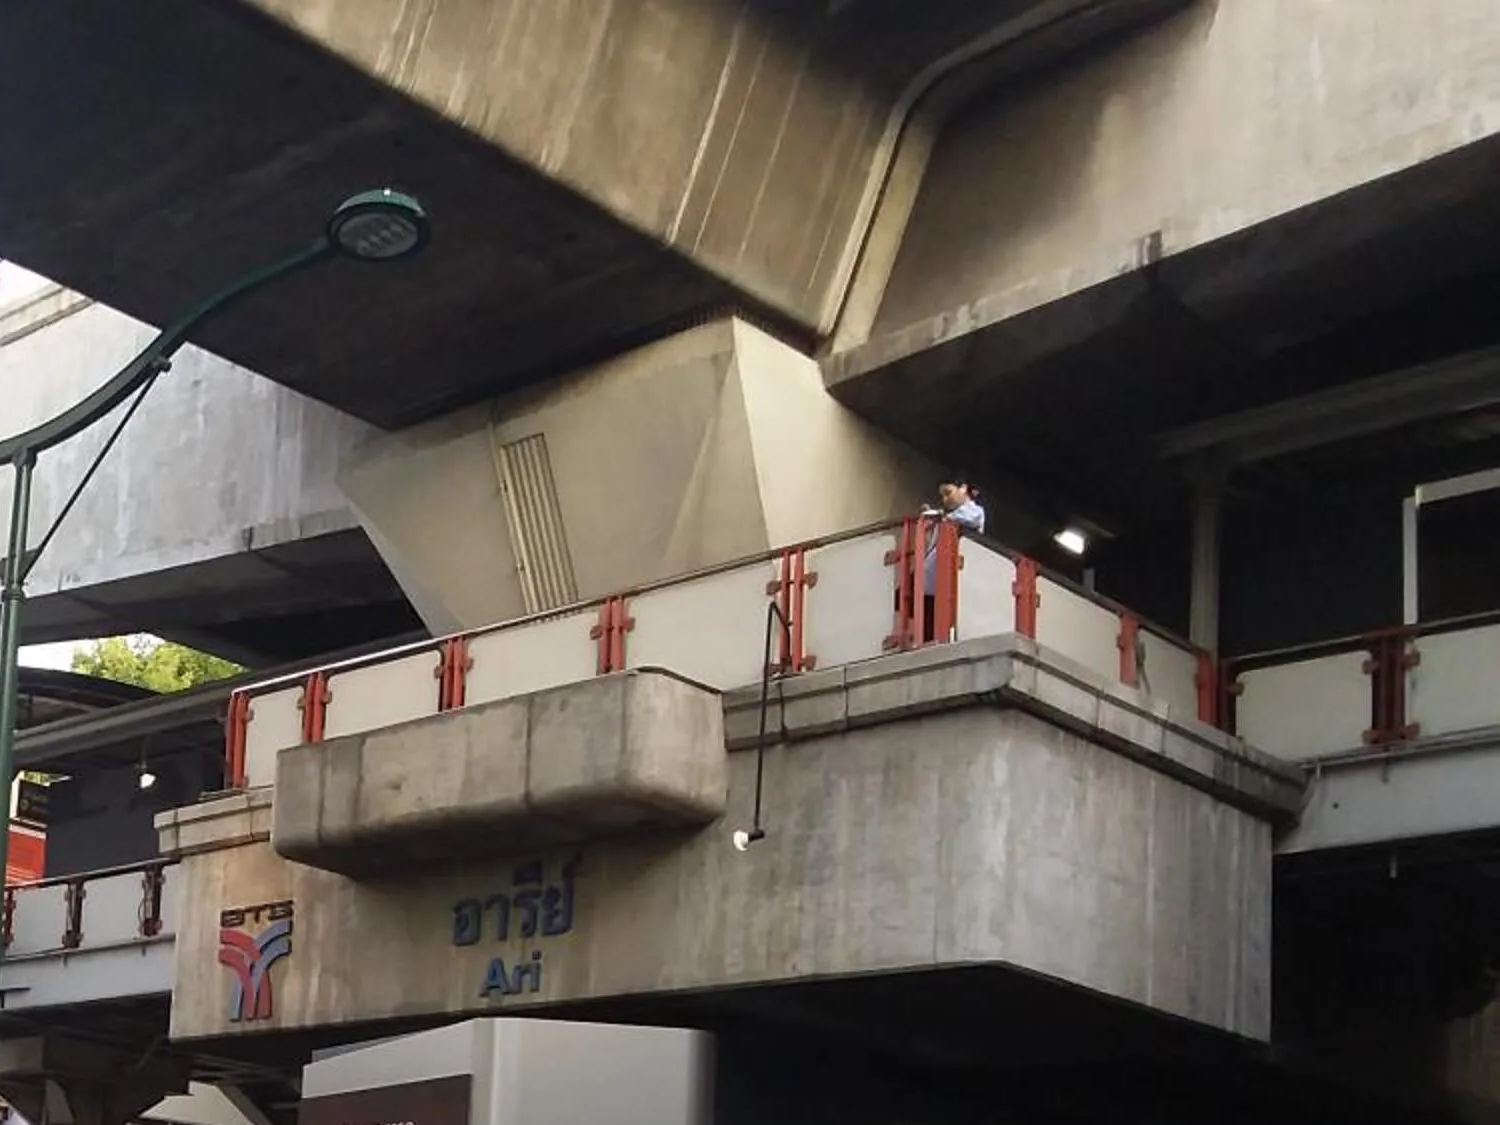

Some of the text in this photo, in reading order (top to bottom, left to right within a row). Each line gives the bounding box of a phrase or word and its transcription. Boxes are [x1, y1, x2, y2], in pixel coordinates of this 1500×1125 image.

[220, 900, 295, 928] BTS
[453, 851, 582, 947] อารีย์
[479, 949, 543, 998] Ari
